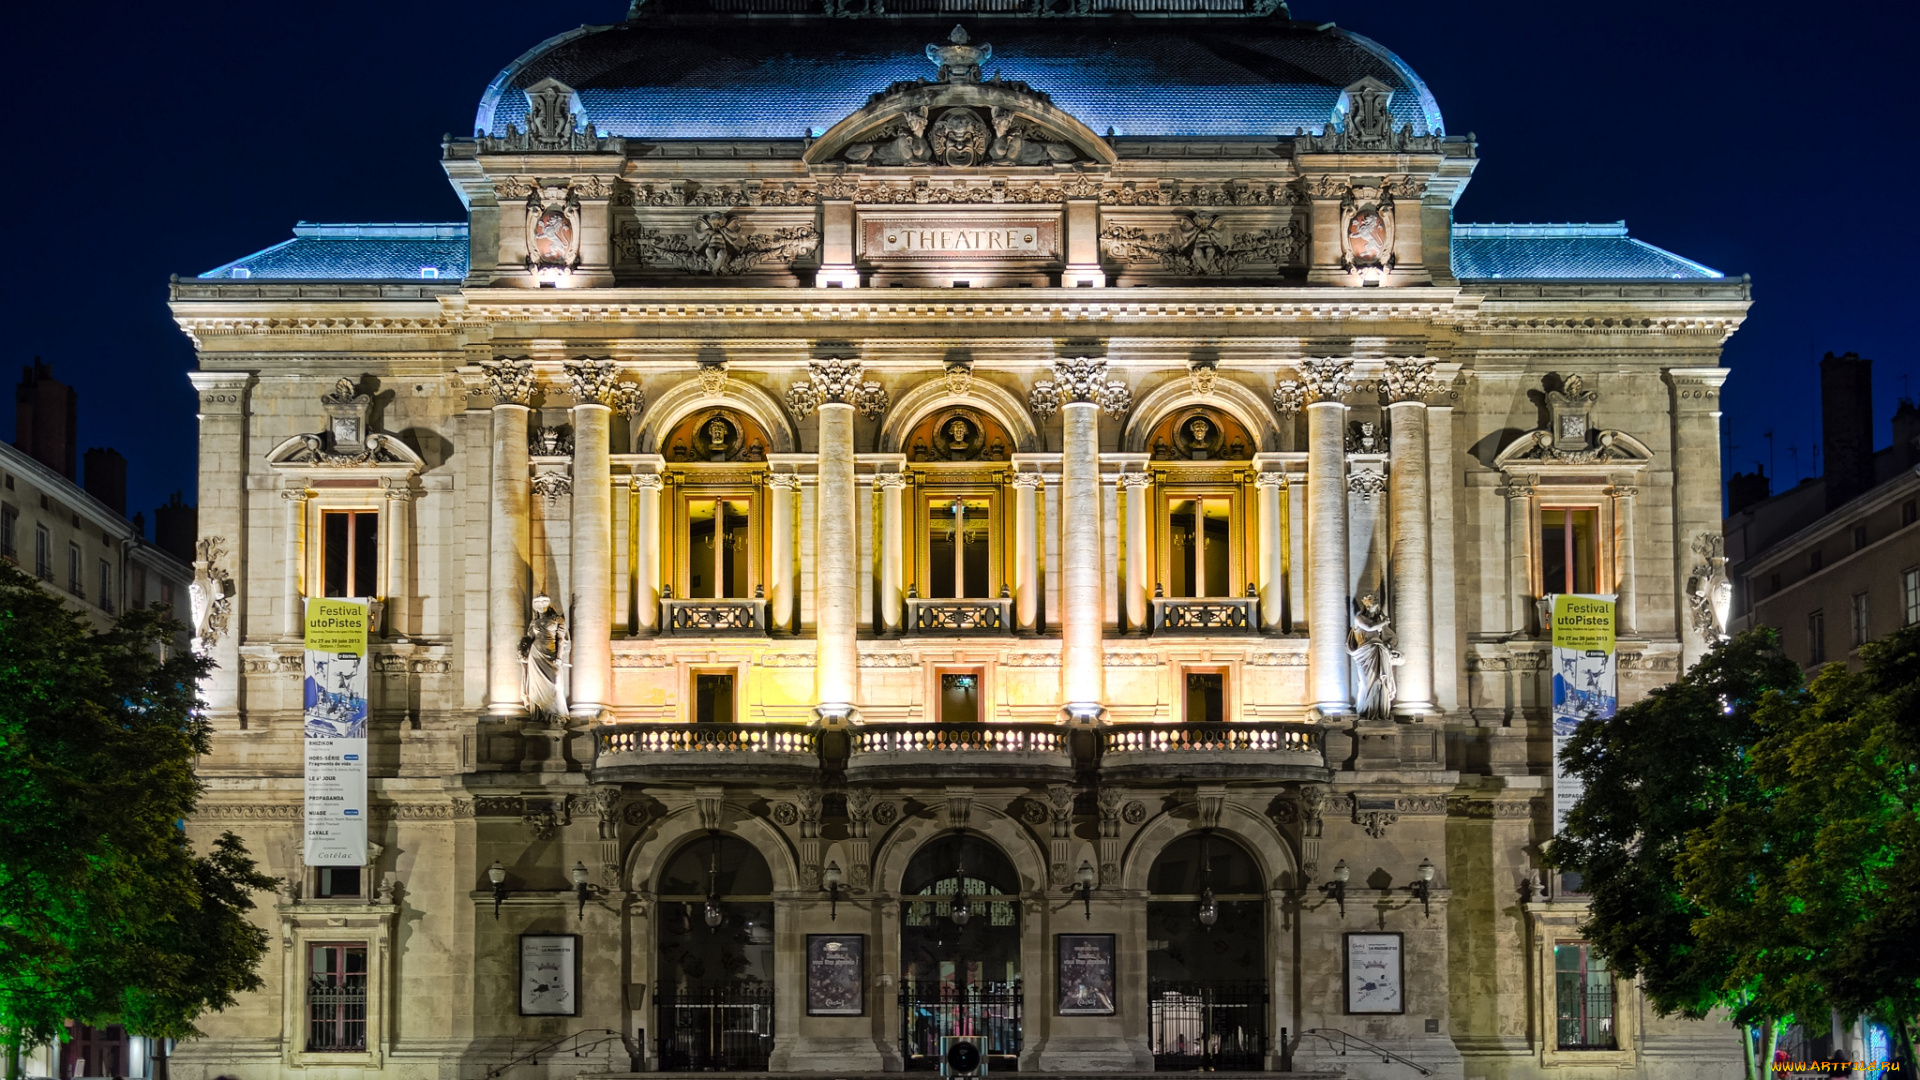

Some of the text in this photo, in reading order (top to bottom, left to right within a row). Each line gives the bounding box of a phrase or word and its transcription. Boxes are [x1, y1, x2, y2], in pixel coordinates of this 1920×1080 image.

[901, 229, 1020, 250] THEATRE
[320, 606, 362, 616] Festival
[1566, 604, 1609, 613] Festival
[310, 618, 362, 628] utoPistes
[1558, 616, 1609, 625] utoPistes
